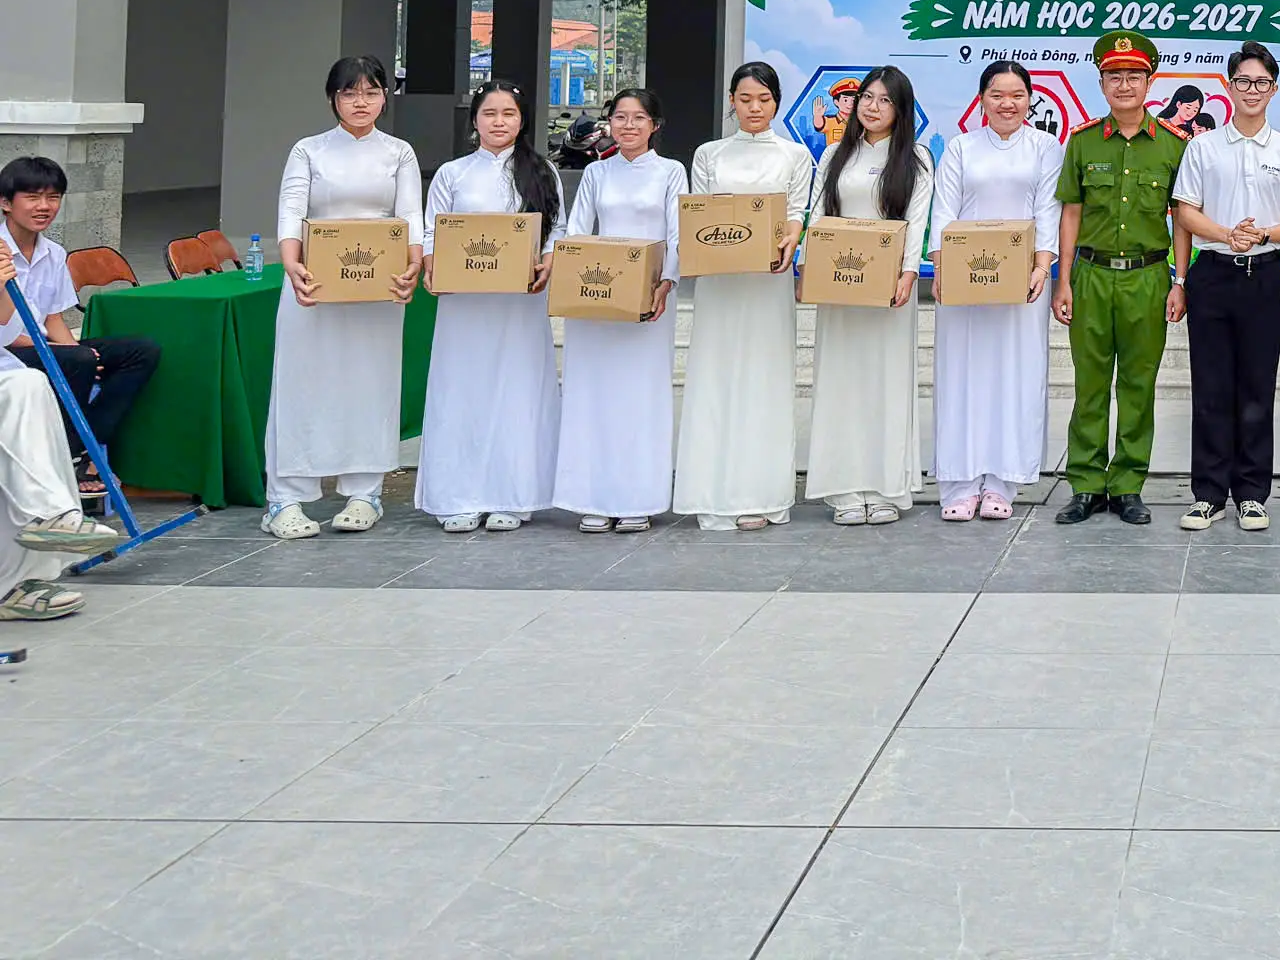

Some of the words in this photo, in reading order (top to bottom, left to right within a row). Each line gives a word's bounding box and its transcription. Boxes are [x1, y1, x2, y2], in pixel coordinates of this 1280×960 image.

[1036, 2, 1095, 34] HỌC
[1101, 2, 1264, 33] 2026-2027
[981, 48, 1008, 61] Phú
[1011, 49, 1038, 61] Hoà
[1042, 50, 1080, 64] Đông,
[1158, 52, 1180, 66] áng
[1183, 52, 1192, 63] 9
[1195, 53, 1224, 64] năm
[704, 227, 744, 241] Asia
[465, 258, 498, 272] Royal
[340, 268, 374, 282] Royal
[832, 271, 864, 285] Royal
[970, 272, 998, 286] Royal
[580, 286, 612, 300] Royal
